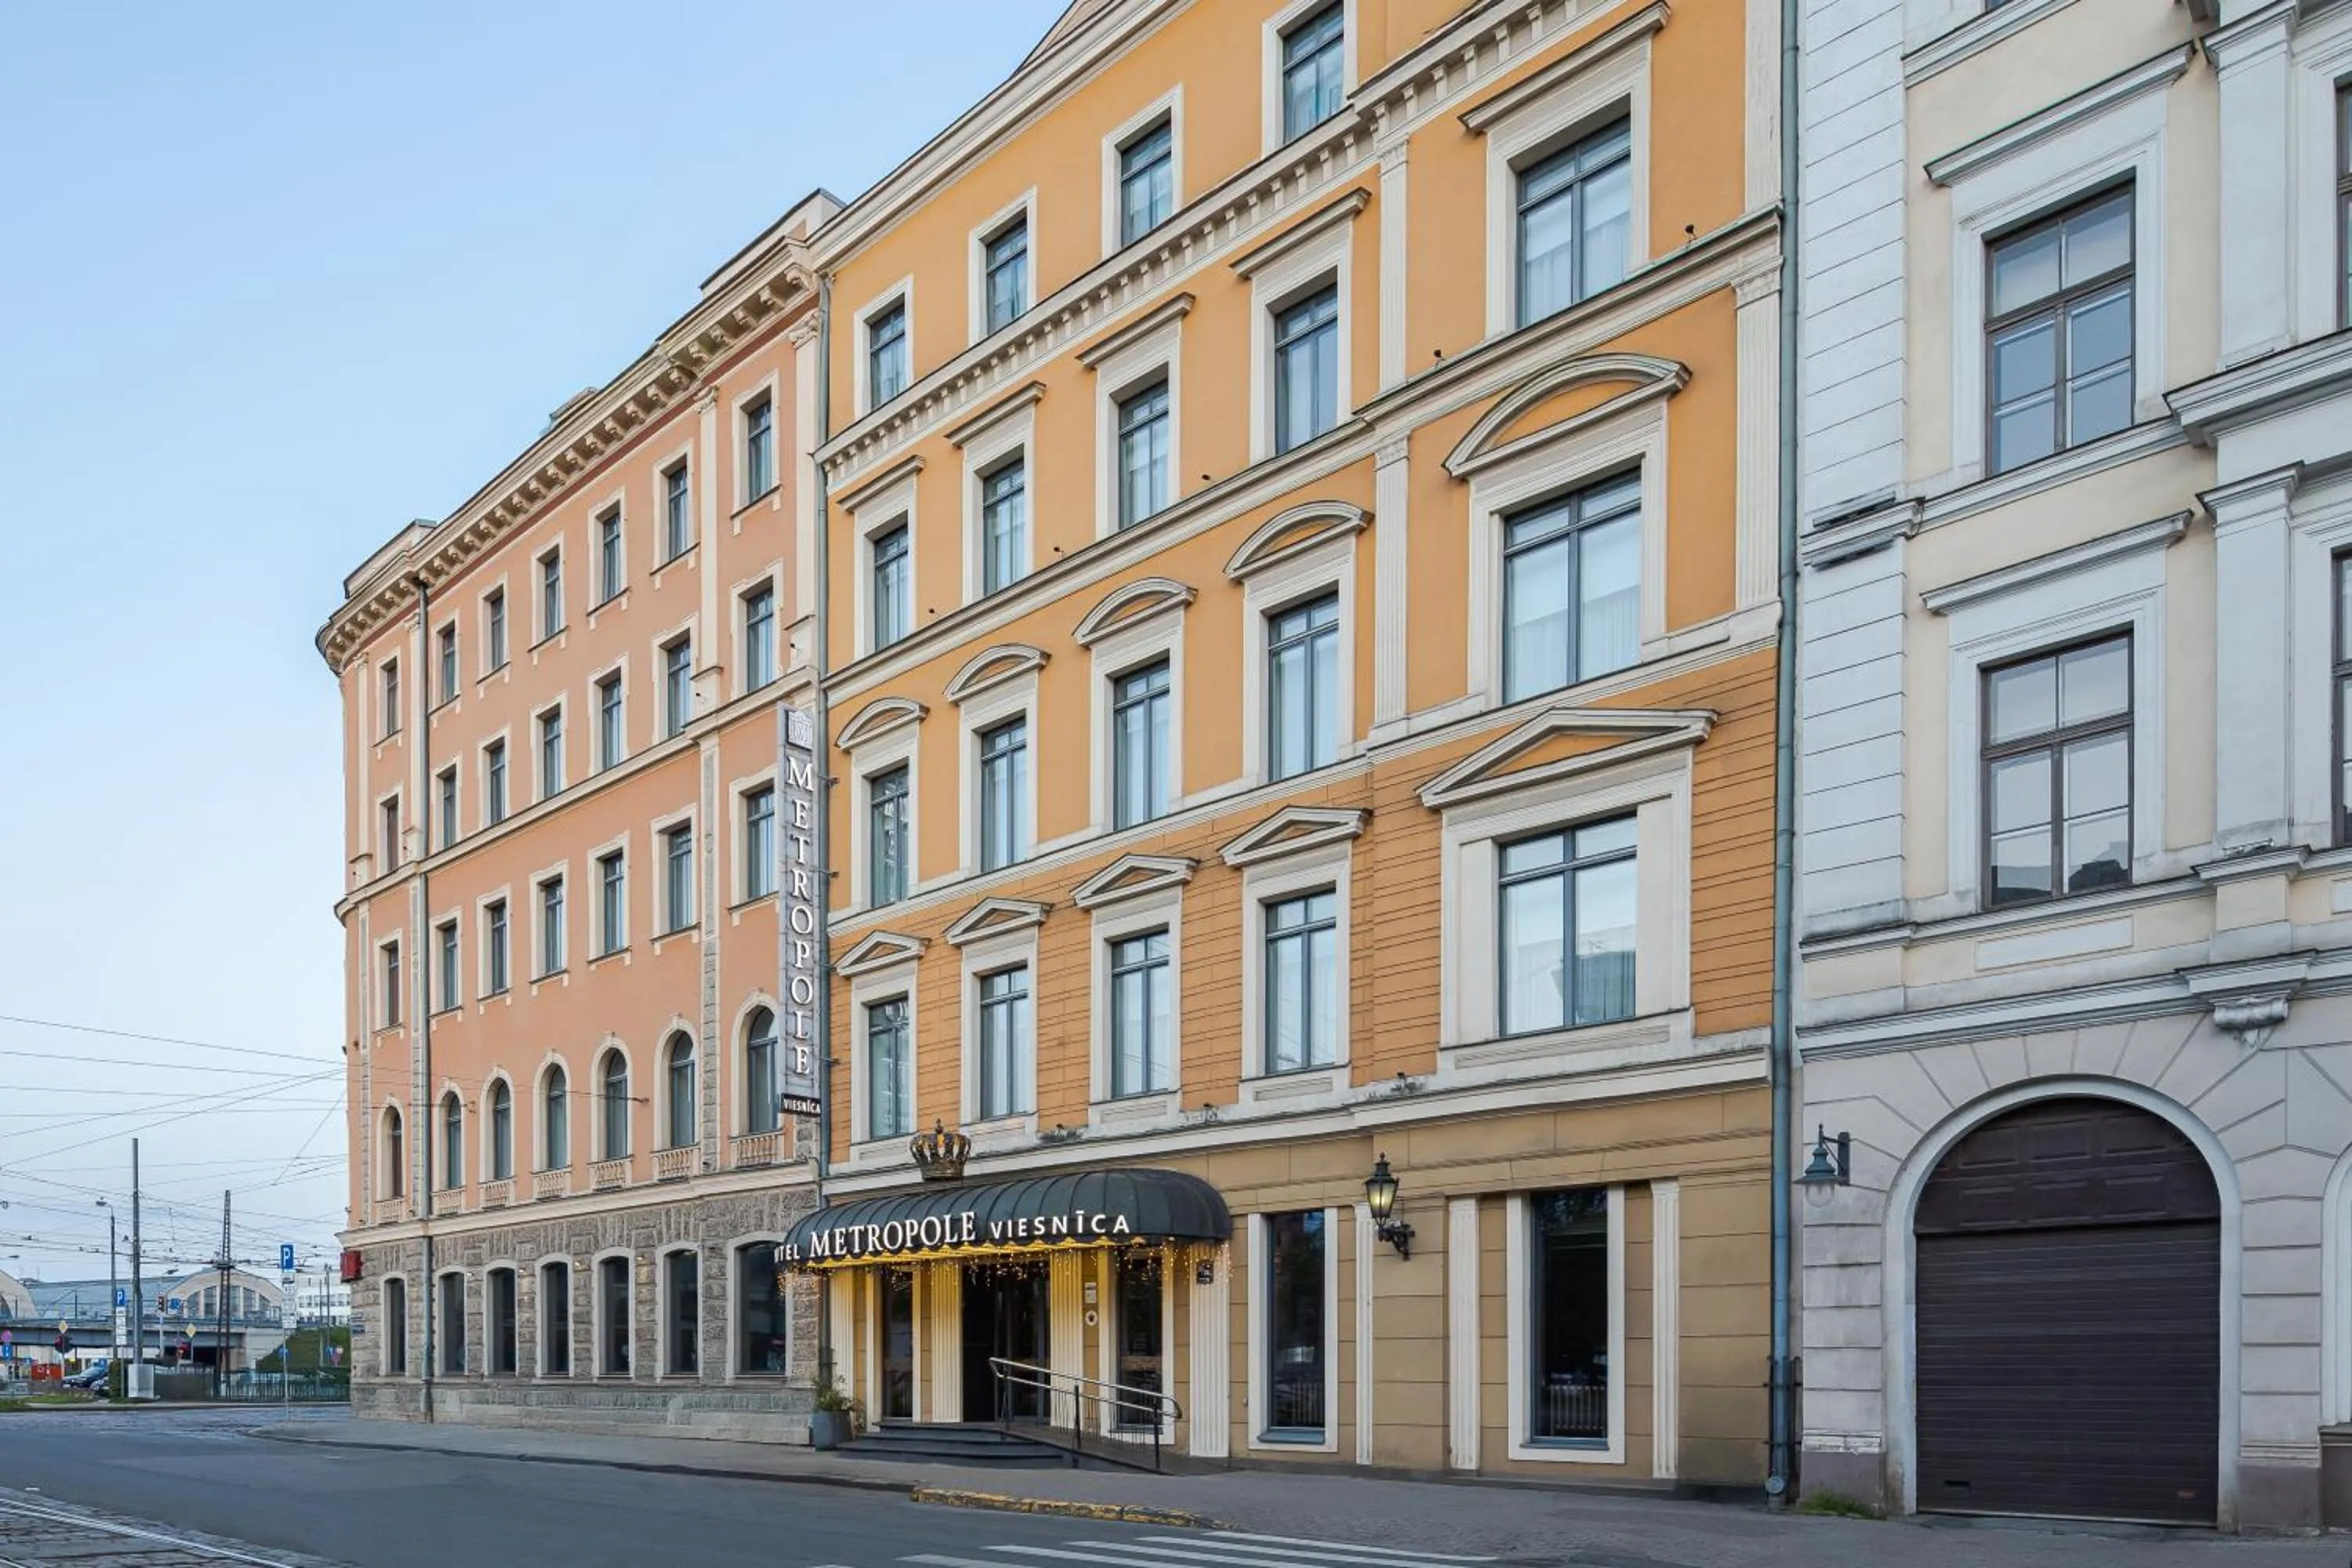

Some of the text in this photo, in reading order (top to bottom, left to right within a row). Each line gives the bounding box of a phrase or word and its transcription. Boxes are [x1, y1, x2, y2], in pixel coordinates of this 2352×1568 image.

[787, 755, 814, 1074] METROPOLE
[809, 1211, 976, 1258] METROPOLE
[991, 1210, 1130, 1240] VIESNĪCA
[283, 1247, 291, 1267] P
[117, 1291, 123, 1305] P
